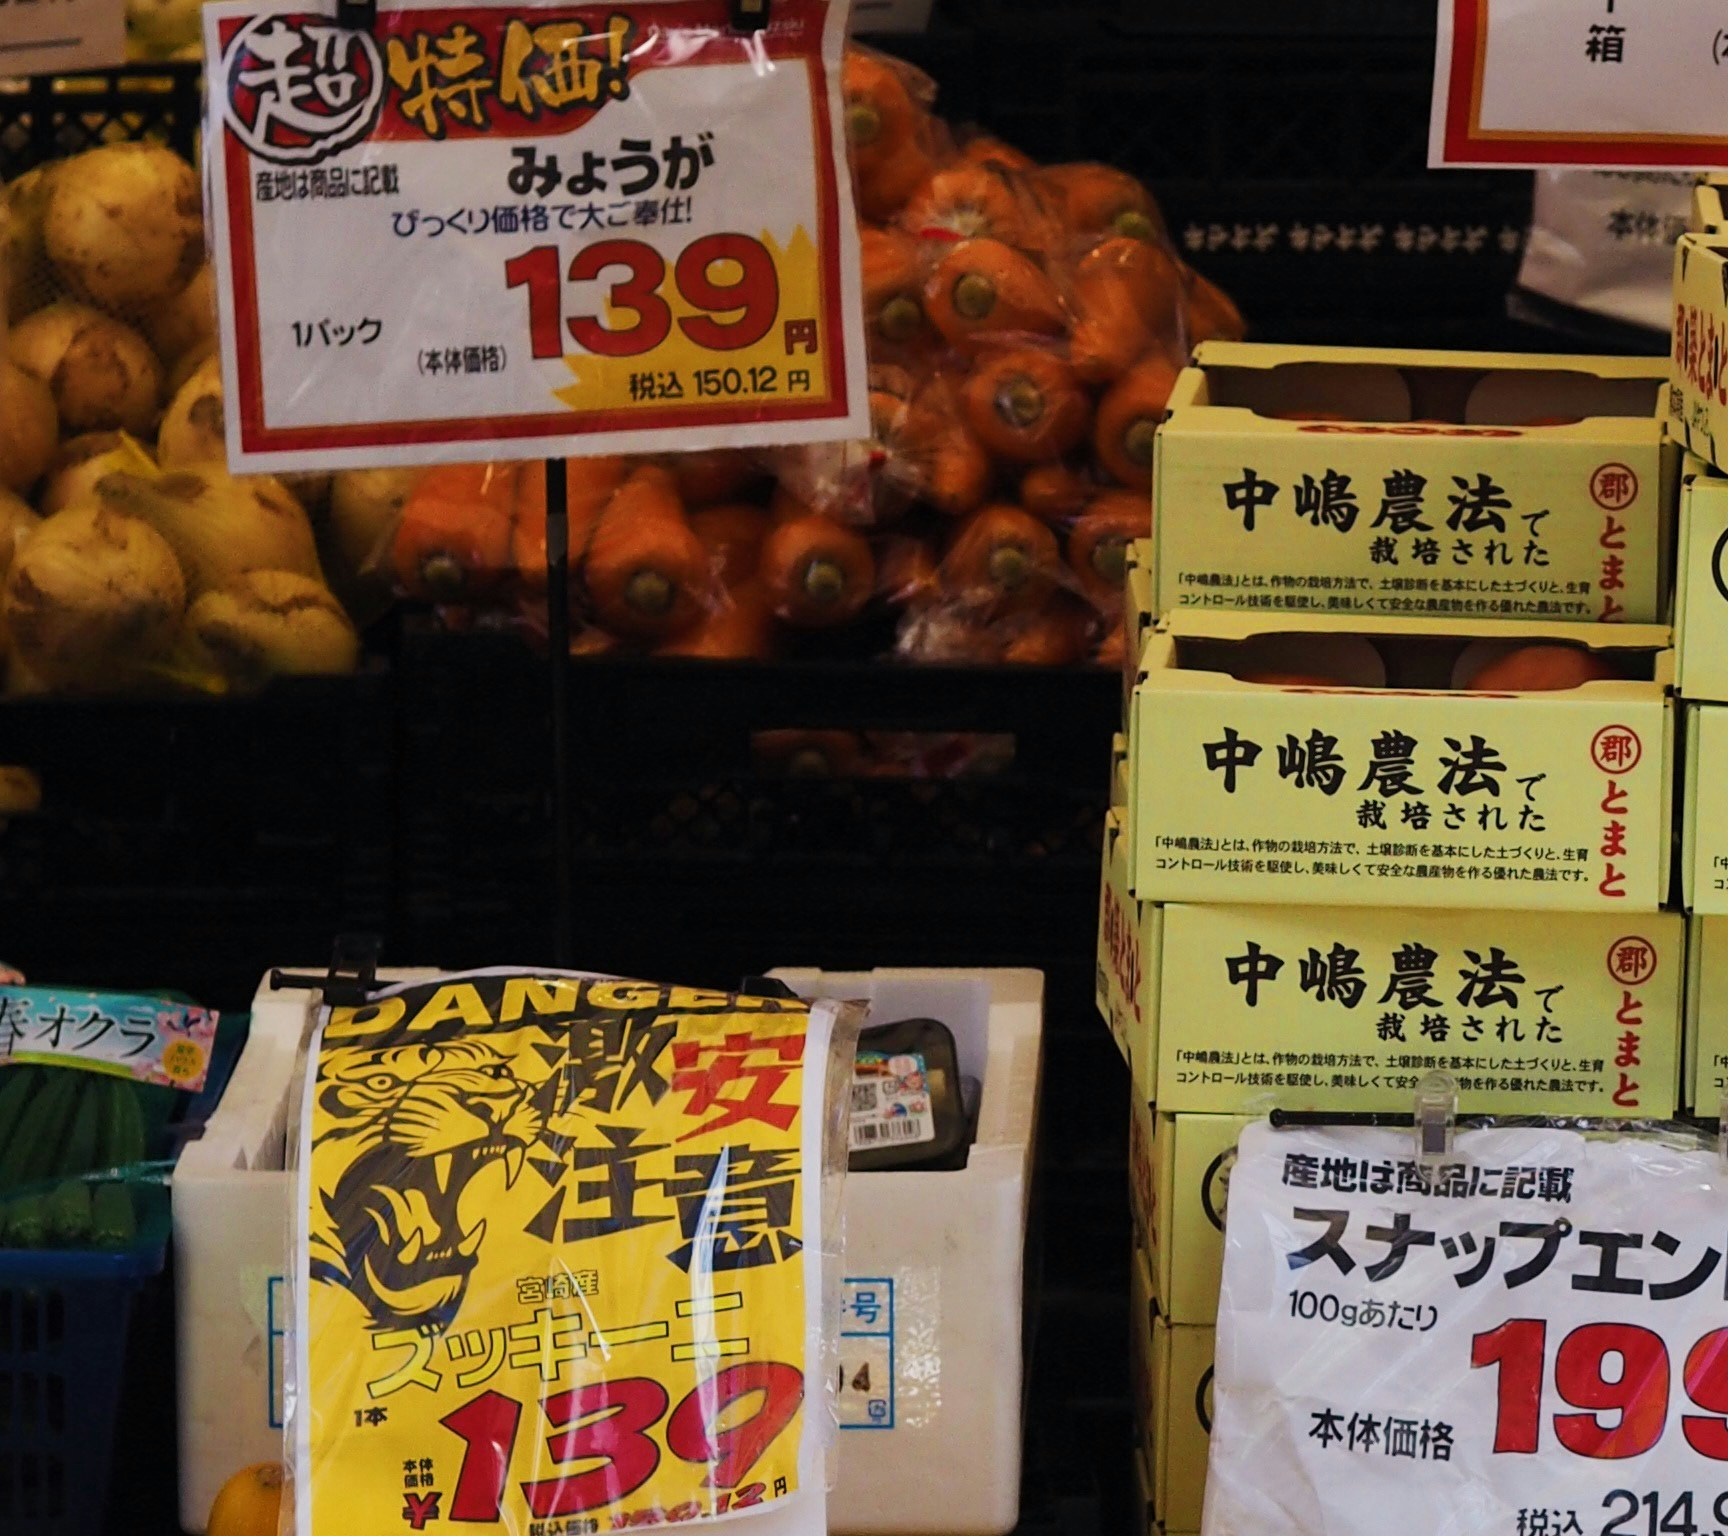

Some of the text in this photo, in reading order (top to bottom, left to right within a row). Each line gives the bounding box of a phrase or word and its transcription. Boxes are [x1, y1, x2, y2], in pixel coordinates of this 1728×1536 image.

[1584, 24, 1626, 65] 箱
[255, 164, 400, 204] 産地は商品に記載
[507, 132, 714, 198] みょうが
[390, 196, 694, 239] びっくり価格で大ご奉仕!
[1368, 535, 1551, 566] 栽培された
[1598, 515, 1628, 624] とまと
[1355, 798, 1547, 833] 栽培された
[1597, 780, 1629, 899] とまと
[1375, 1012, 1564, 1044] 栽培された
[1611, 990, 1645, 1110] とまと
[528, 1012, 806, 1146] 激安
[524, 1127, 806, 1276] 注意
[1280, 1152, 1576, 1204] 産地は商品に記載
[514, 1268, 600, 1308] 宮崎産
[1287, 1288, 1440, 1333] 100gあたり
[366, 1290, 752, 1402] ズッキーニ
[352, 1403, 391, 1430] 1本
[1308, 1406, 1455, 1462] 本体価格
